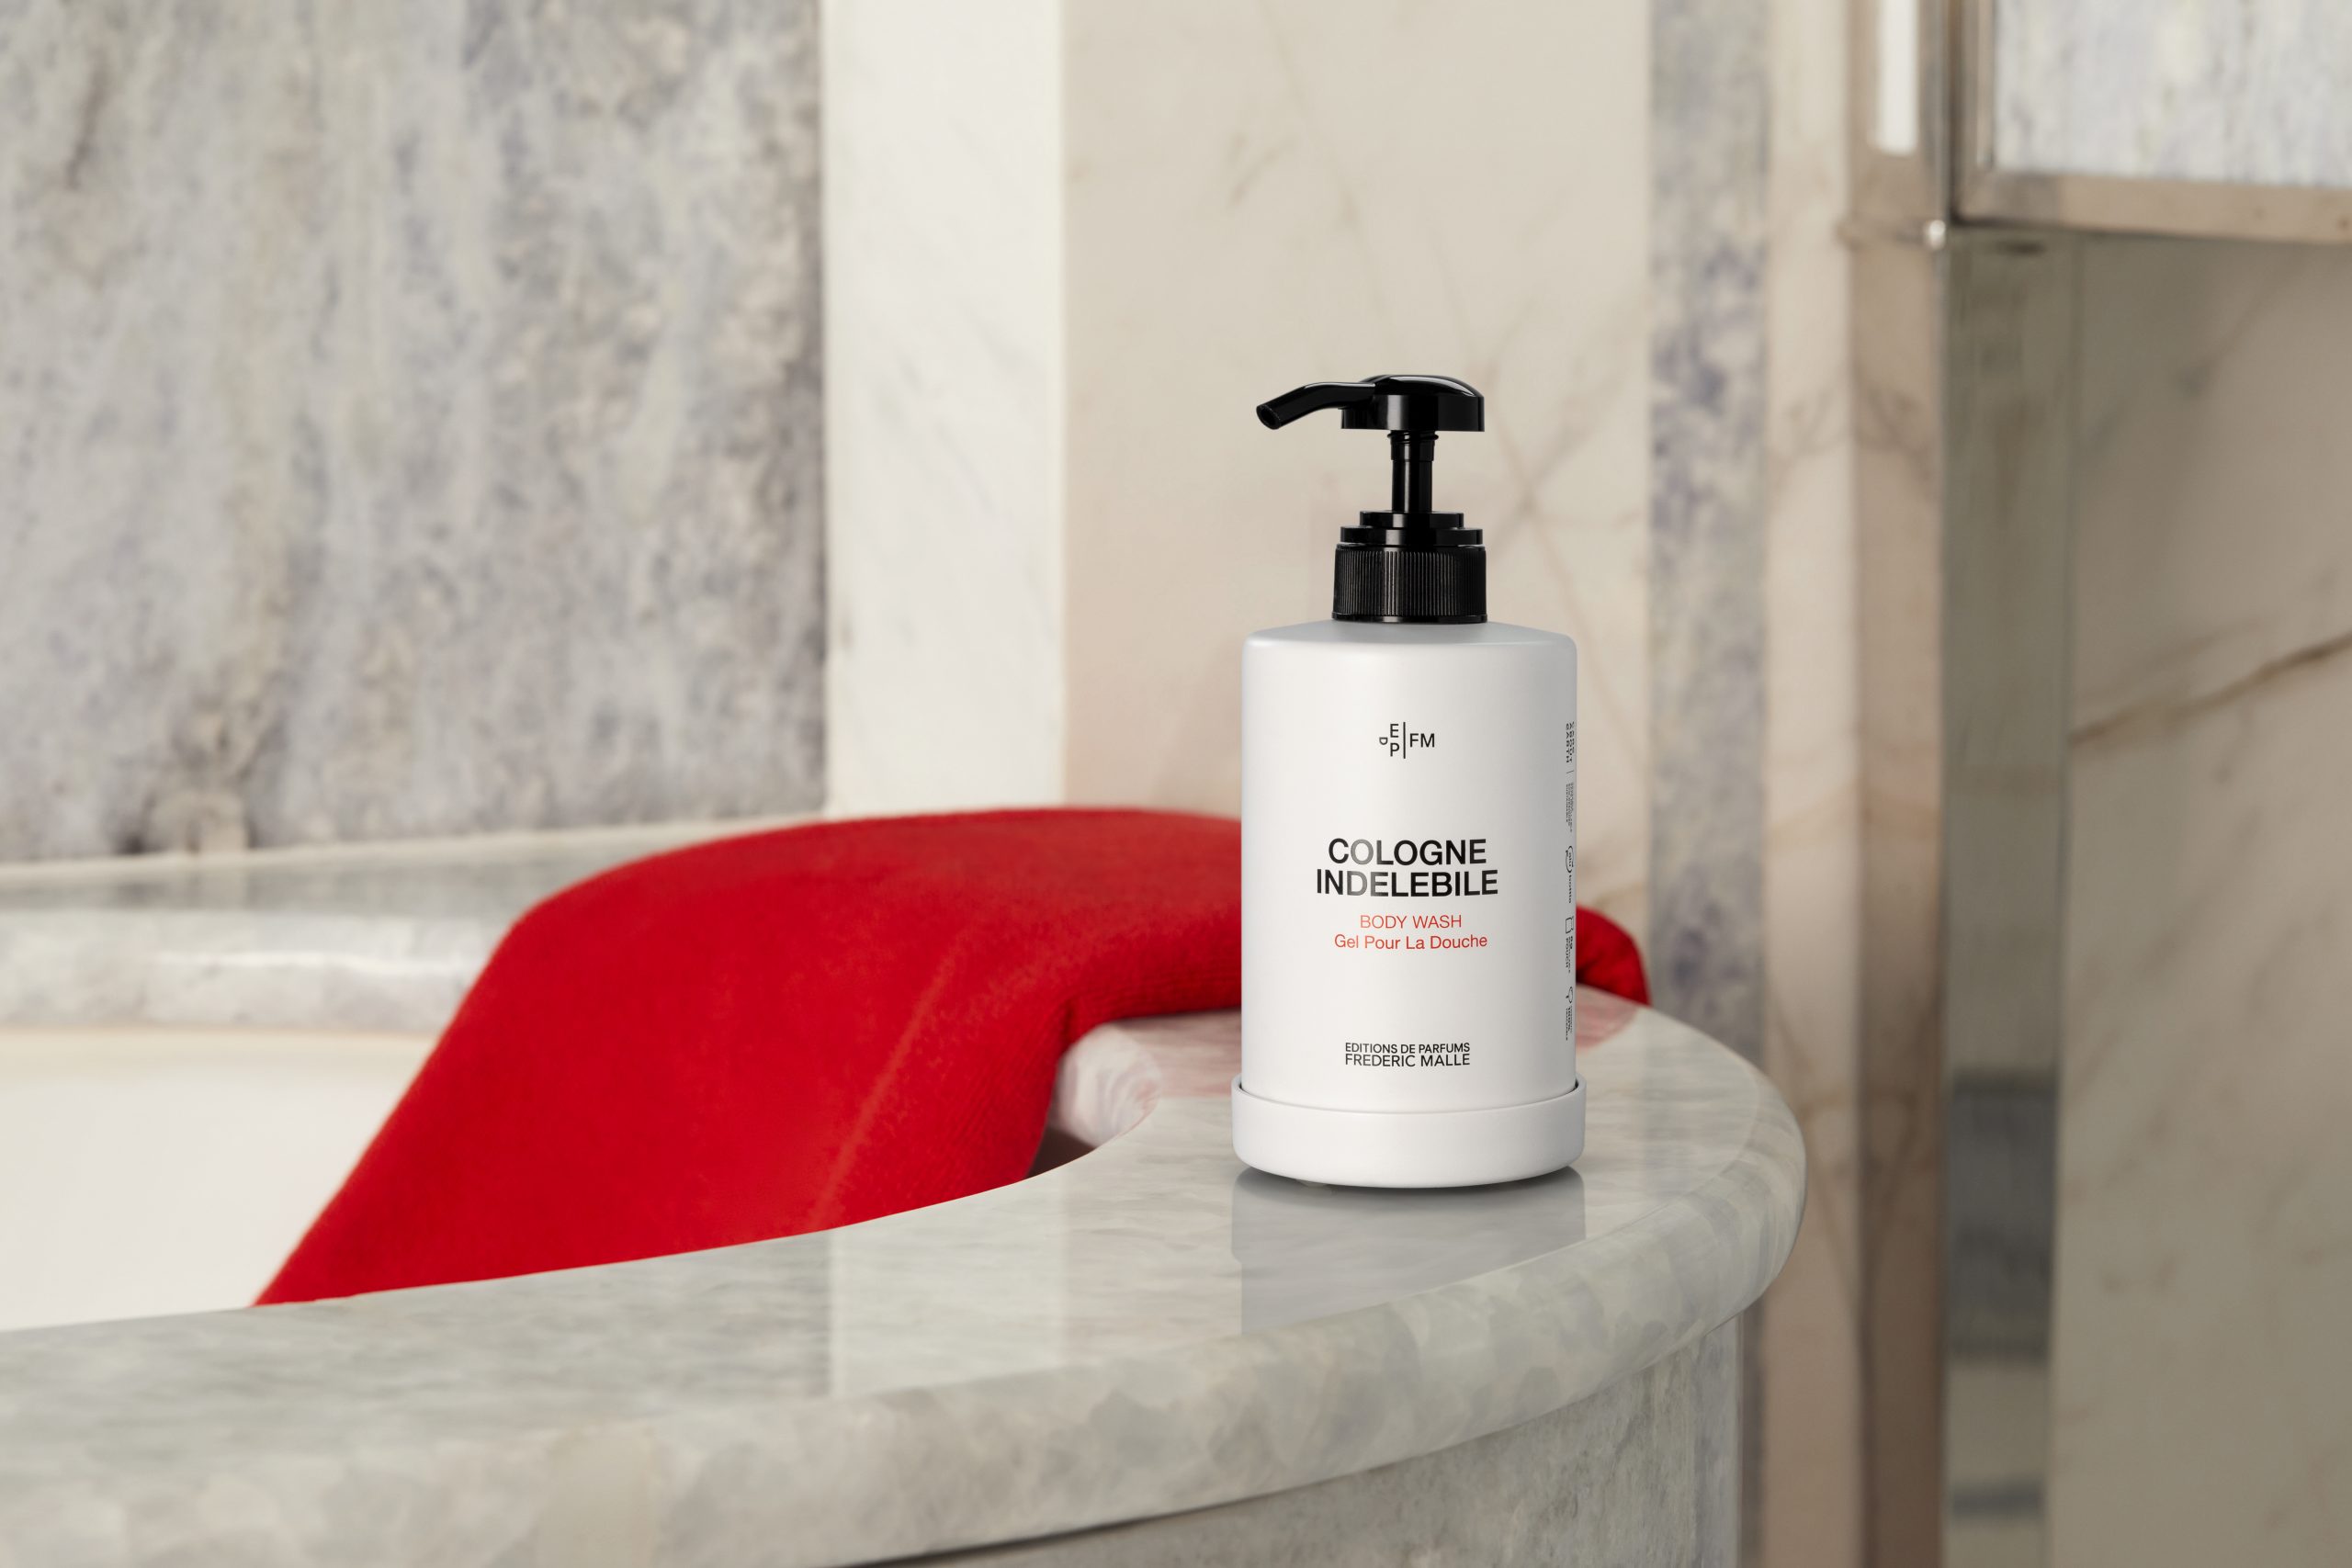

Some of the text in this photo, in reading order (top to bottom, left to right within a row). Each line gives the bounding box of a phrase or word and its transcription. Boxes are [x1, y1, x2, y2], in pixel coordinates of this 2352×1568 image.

[1409, 732, 1435, 748] FM
[1329, 838, 1487, 865] COLOGNE
[1317, 868, 1498, 897] INDELEBILE
[1360, 914, 1462, 929] BODY WASH
[1334, 933, 1488, 950] Gel Pour La Douche
[1345, 1042, 1470, 1055] EDITIONS DE PARFUMS
[1345, 1053, 1471, 1067] FREDERIC MALLE
